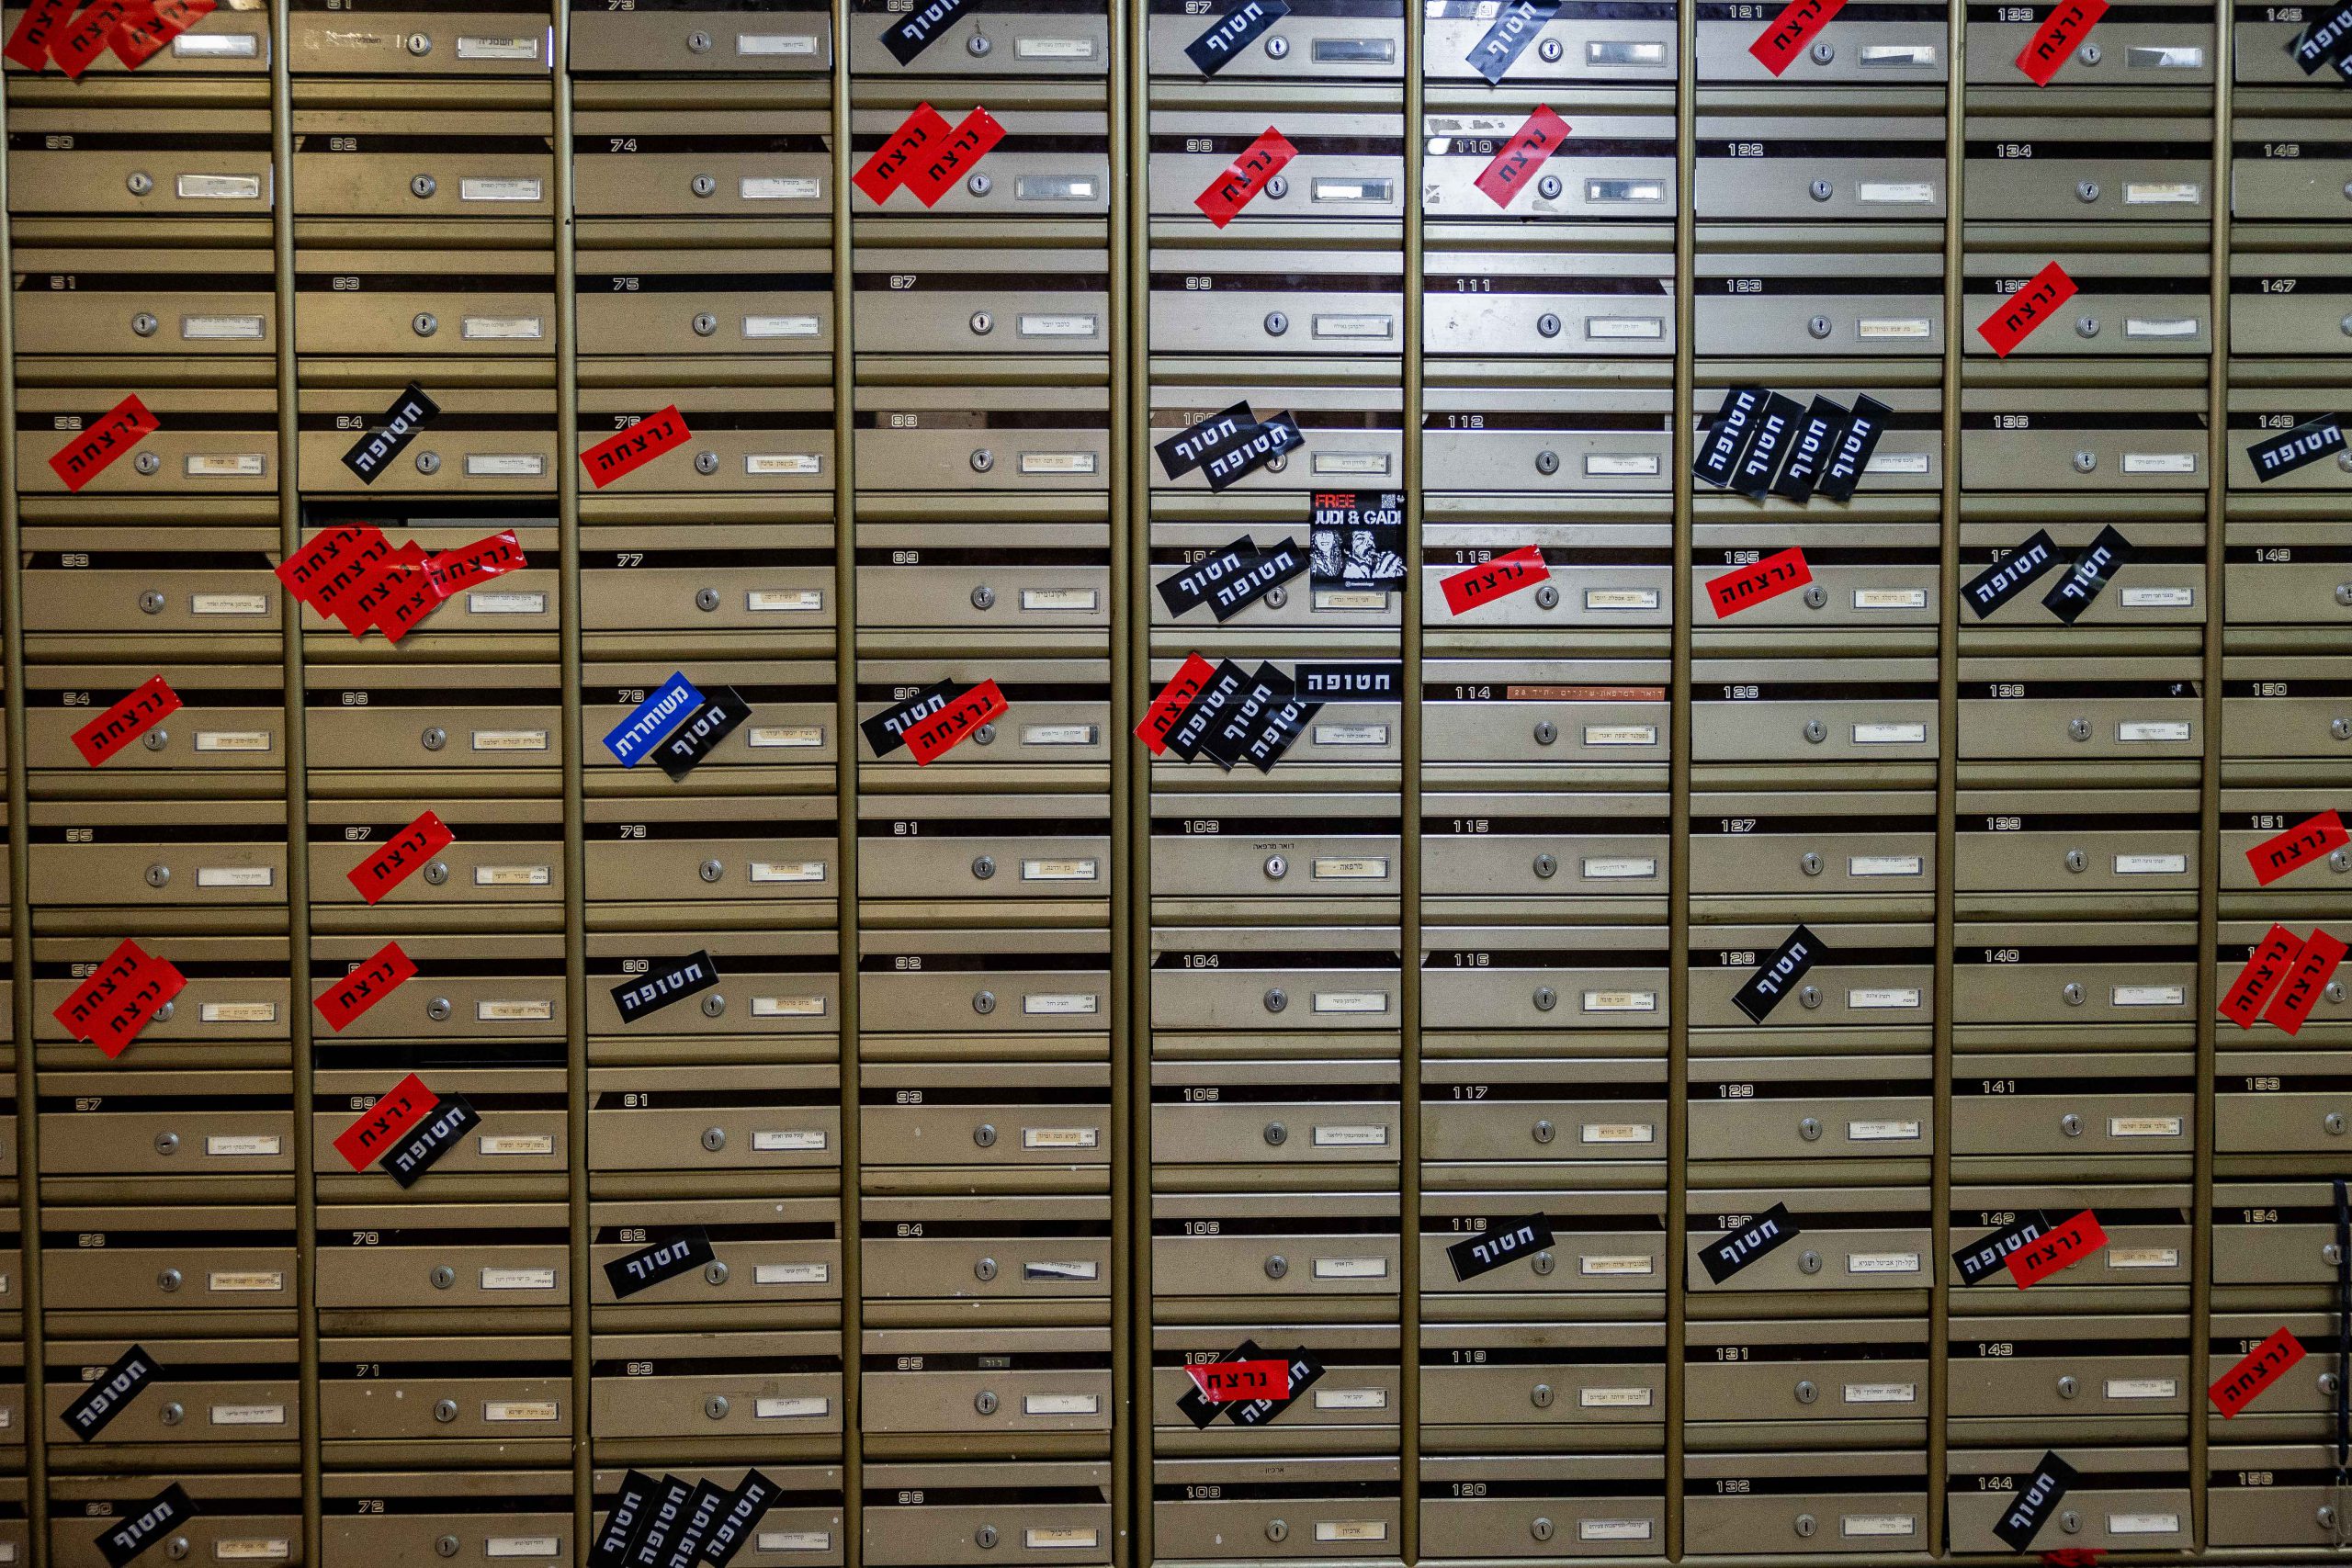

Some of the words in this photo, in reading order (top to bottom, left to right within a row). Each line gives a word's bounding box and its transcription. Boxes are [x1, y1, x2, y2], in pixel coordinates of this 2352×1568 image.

[1185, 0, 1212, 15] 97
[1729, 5, 1762, 18] 121
[1997, 7, 2034, 22] 133
[71, 3, 124, 52] נרצח
[1207, 2, 1261, 51] חטוף
[1487, 0, 1536, 53] חטוף
[1773, 0, 1822, 51] נרצח
[2038, 8, 2085, 60] נרצח
[330, 137, 357, 152] 62
[610, 138, 638, 152] 74
[1186, 139, 1213, 152] 98
[1456, 140, 1492, 153] 110
[1728, 142, 1764, 157] 122
[1996, 144, 2032, 158] 134
[876, 129, 927, 179] נרצח
[929, 131, 979, 182] נרצח
[1498, 128, 1547, 183] נרצח
[1223, 151, 1272, 202] נרצח
[333, 276, 360, 290] 63
[613, 277, 639, 291] 75
[890, 275, 917, 289] 87
[1185, 276, 1212, 290] 99
[1456, 278, 1490, 292] 111
[1726, 279, 1762, 293] 123
[2261, 279, 2297, 293] 147
[2006, 281, 2057, 332] נרצח
[54, 416, 82, 430] 52
[336, 415, 363, 429] 64
[1448, 414, 1484, 429] 112
[1993, 415, 2029, 429] 136
[2259, 414, 2294, 428] 148
[356, 400, 423, 472] חטופה
[1708, 391, 1756, 471] חטופה
[66, 412, 139, 473] נרצחה
[597, 420, 675, 470] נרצחה
[1175, 419, 1238, 460] חטוף
[1746, 414, 1785, 476] חטוף
[2262, 423, 2341, 470] חטופה
[1210, 425, 1288, 478] חטופה
[1789, 418, 1827, 479] חטוף
[1831, 418, 1871, 478] חטוף
[1315, 494, 1356, 508] FREE
[1315, 510, 1343, 525] JUDI
[1348, 511, 1359, 525] &
[1363, 511, 1401, 525] GADI
[62, 553, 89, 568] 53
[293, 525, 363, 583] נרצחה
[616, 553, 644, 567] 77
[892, 550, 919, 564] 89
[1455, 550, 1491, 564] 113
[1724, 550, 1759, 565] 125
[2256, 548, 2290, 562] 149
[319, 540, 388, 603] נרצחה
[431, 545, 511, 586] נרצחה
[1180, 553, 1240, 596] חטוף
[1217, 551, 1294, 606] חטופה
[1465, 560, 1524, 596] נרצח
[1975, 543, 2047, 604] חטופה
[2063, 547, 2110, 602] חטוף
[358, 562, 413, 613] נרצח
[1719, 560, 1796, 604] נרצחה
[1308, 674, 1389, 690] חטופה
[2252, 682, 2288, 696] 150
[618, 689, 645, 703] 78
[1455, 686, 1491, 700] 114
[1724, 685, 1758, 699] 126
[1989, 683, 2025, 697] 138
[342, 692, 368, 705] 66
[1153, 679, 1198, 733] נרצח
[884, 693, 946, 737] חטוף
[1177, 675, 1239, 748] חטופה
[1224, 684, 1272, 740] חטוף
[90, 691, 164, 750] נרצחה
[615, 685, 690, 757] משוחררת
[920, 695, 993, 750] נרצחה
[672, 705, 727, 759] חטוף
[893, 821, 918, 835] 91
[1183, 819, 1219, 834] 103
[1453, 819, 1488, 833] 115
[1721, 818, 1757, 832] 127
[1986, 817, 2021, 830] 139
[2251, 815, 2283, 829] 151
[66, 829, 93, 842] 55
[345, 827, 371, 840] 67
[620, 825, 647, 839] 79
[372, 831, 427, 880] נרצח
[2269, 829, 2326, 868] נרצח
[1340, 863, 1363, 871] מרפאה
[895, 956, 922, 970] 92
[1183, 954, 1219, 968] 104
[1454, 953, 1489, 966] 116
[1720, 952, 1756, 965] 128
[1984, 949, 2019, 963] 140
[622, 959, 650, 973] 80
[1757, 942, 1806, 998] חטוף
[2236, 939, 2289, 1012] נרצחה
[2284, 953, 2325, 1009] נרצח
[71, 956, 138, 1022] נרצחה
[339, 962, 395, 1010] נרצח
[622, 963, 703, 1010] חטופה
[110, 980, 162, 1033] נרצח
[1183, 1088, 1219, 1101] 105
[1453, 1086, 1488, 1100] 117
[1719, 1084, 1754, 1098] 129
[1983, 1080, 2015, 1094] 141
[624, 1093, 648, 1107] 81
[896, 1090, 922, 1104] 93
[359, 1098, 412, 1146] נרצח
[395, 1107, 467, 1172] חטופה
[897, 1223, 923, 1236] 94
[1184, 1221, 1220, 1235] 106
[1452, 1217, 1487, 1231] 118
[353, 1231, 379, 1246] 70
[619, 1228, 646, 1242] 82
[1720, 1220, 1779, 1264] חטוף
[1472, 1226, 1534, 1263] חטוף
[1963, 1224, 2040, 1273] חטופה
[2025, 1229, 2084, 1269] נרצח
[627, 1241, 691, 1279] חטוף
[1452, 1350, 1487, 1363] 119
[1716, 1347, 1748, 1360] 131
[1978, 1343, 2013, 1357] 143
[627, 1361, 653, 1375] 83
[897, 1356, 923, 1371] 95
[1207, 1372, 1267, 1388] נרצח
[2223, 1341, 2290, 1404] נרצחה
[75, 1359, 147, 1427] חטופה
[1978, 1476, 2013, 1490] 144
[899, 1491, 924, 1504] 96
[2009, 1471, 2055, 1530] חטוף
[113, 1501, 174, 1551] חטוף
[604, 1492, 642, 1552] חטוף
[639, 1486, 687, 1564] חטופה
[706, 1483, 765, 1557] חטופה
[669, 1494, 720, 1568] חטופה
[1341, 1528, 1361, 1536] ארכיון
